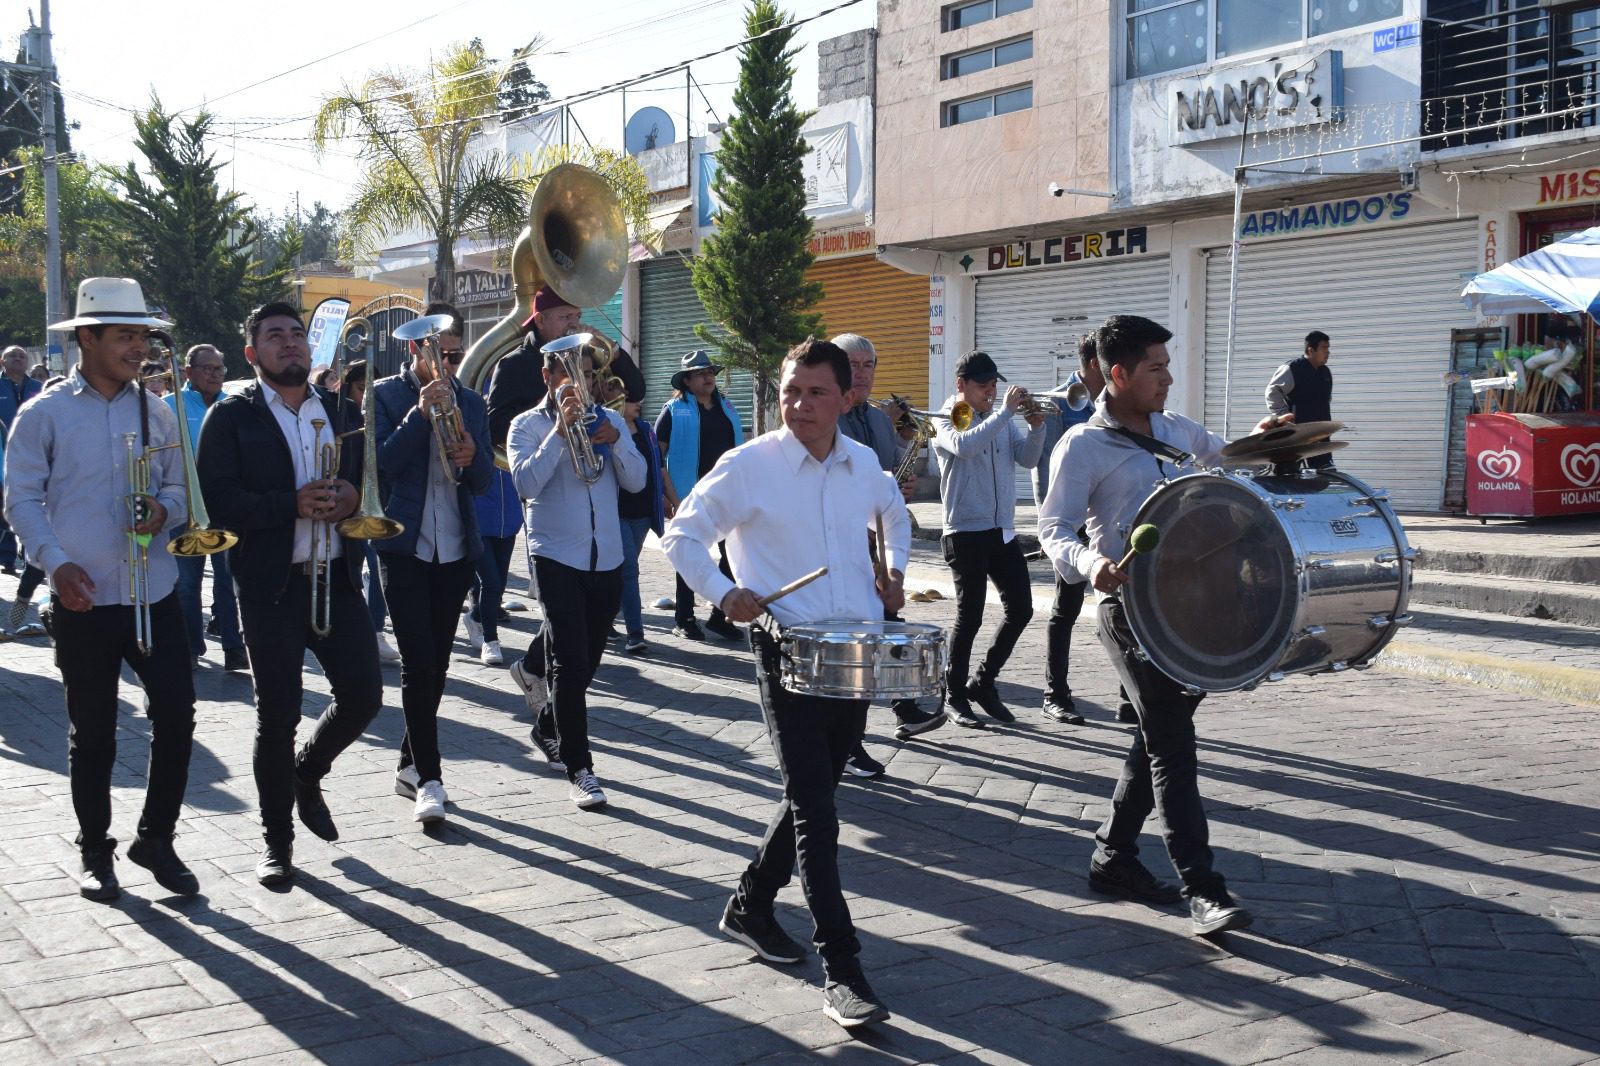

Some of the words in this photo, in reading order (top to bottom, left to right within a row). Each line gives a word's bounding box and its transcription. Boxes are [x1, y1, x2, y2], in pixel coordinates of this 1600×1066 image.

[1375, 32, 1394, 48] WC
[1176, 62, 1299, 132] NANO'S
[1242, 192, 1412, 236] ARMANDO'S
[848, 231, 870, 249] VIDEO
[987, 226, 1147, 270] DULCERIA
[1478, 481, 1521, 491] HOLANDA
